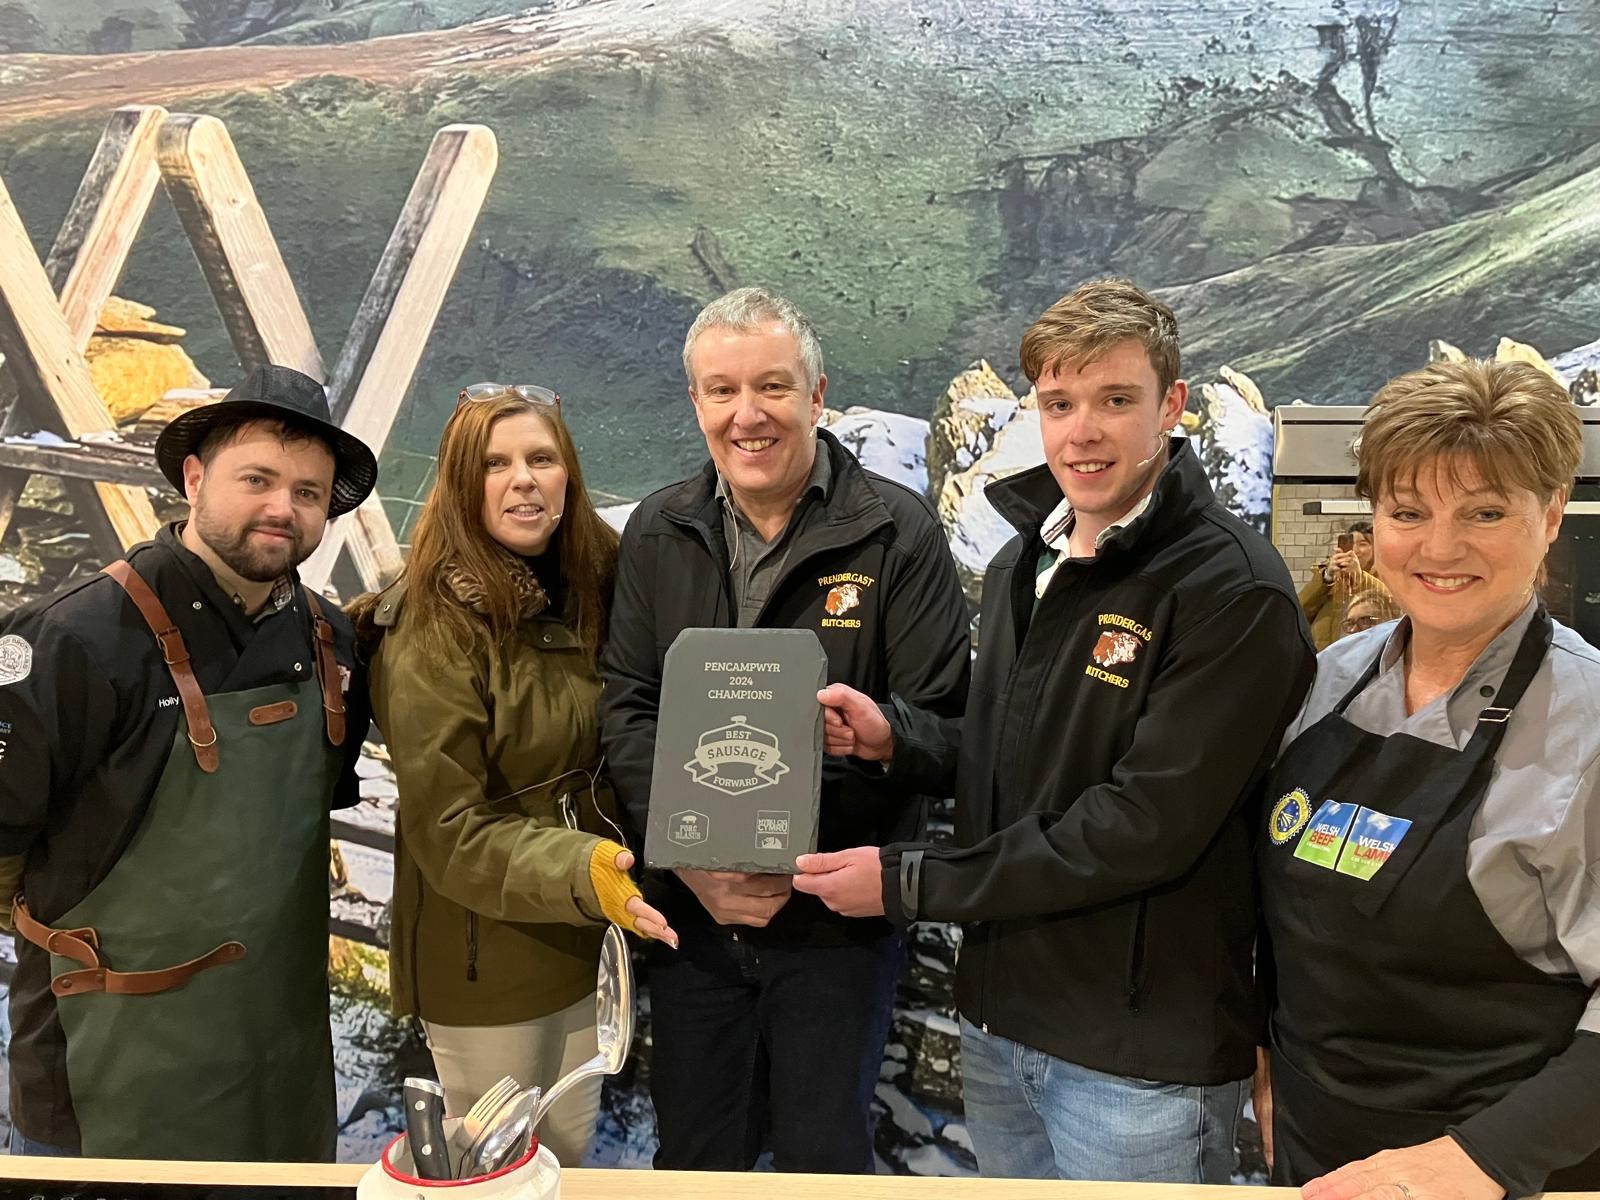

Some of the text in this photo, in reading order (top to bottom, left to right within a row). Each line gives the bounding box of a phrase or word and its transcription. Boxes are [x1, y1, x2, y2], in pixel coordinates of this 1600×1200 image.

[818, 573, 875, 587] PRENDERGAST
[821, 618, 861, 628] BUTCHERS
[1098, 613, 1153, 641] PRENDERGAS
[704, 662, 781, 672] PENCAMPWYR
[729, 676, 753, 686] 2024
[708, 690, 773, 700] CHAMPIONS
[158, 696, 179, 707] Holly
[725, 730, 752, 740] BEST
[707, 745, 768, 761] SAUSAGE
[713, 776, 758, 788] FORWARD
[1315, 822, 1341, 837] WELSH
[1309, 830, 1336, 846] BEEF
